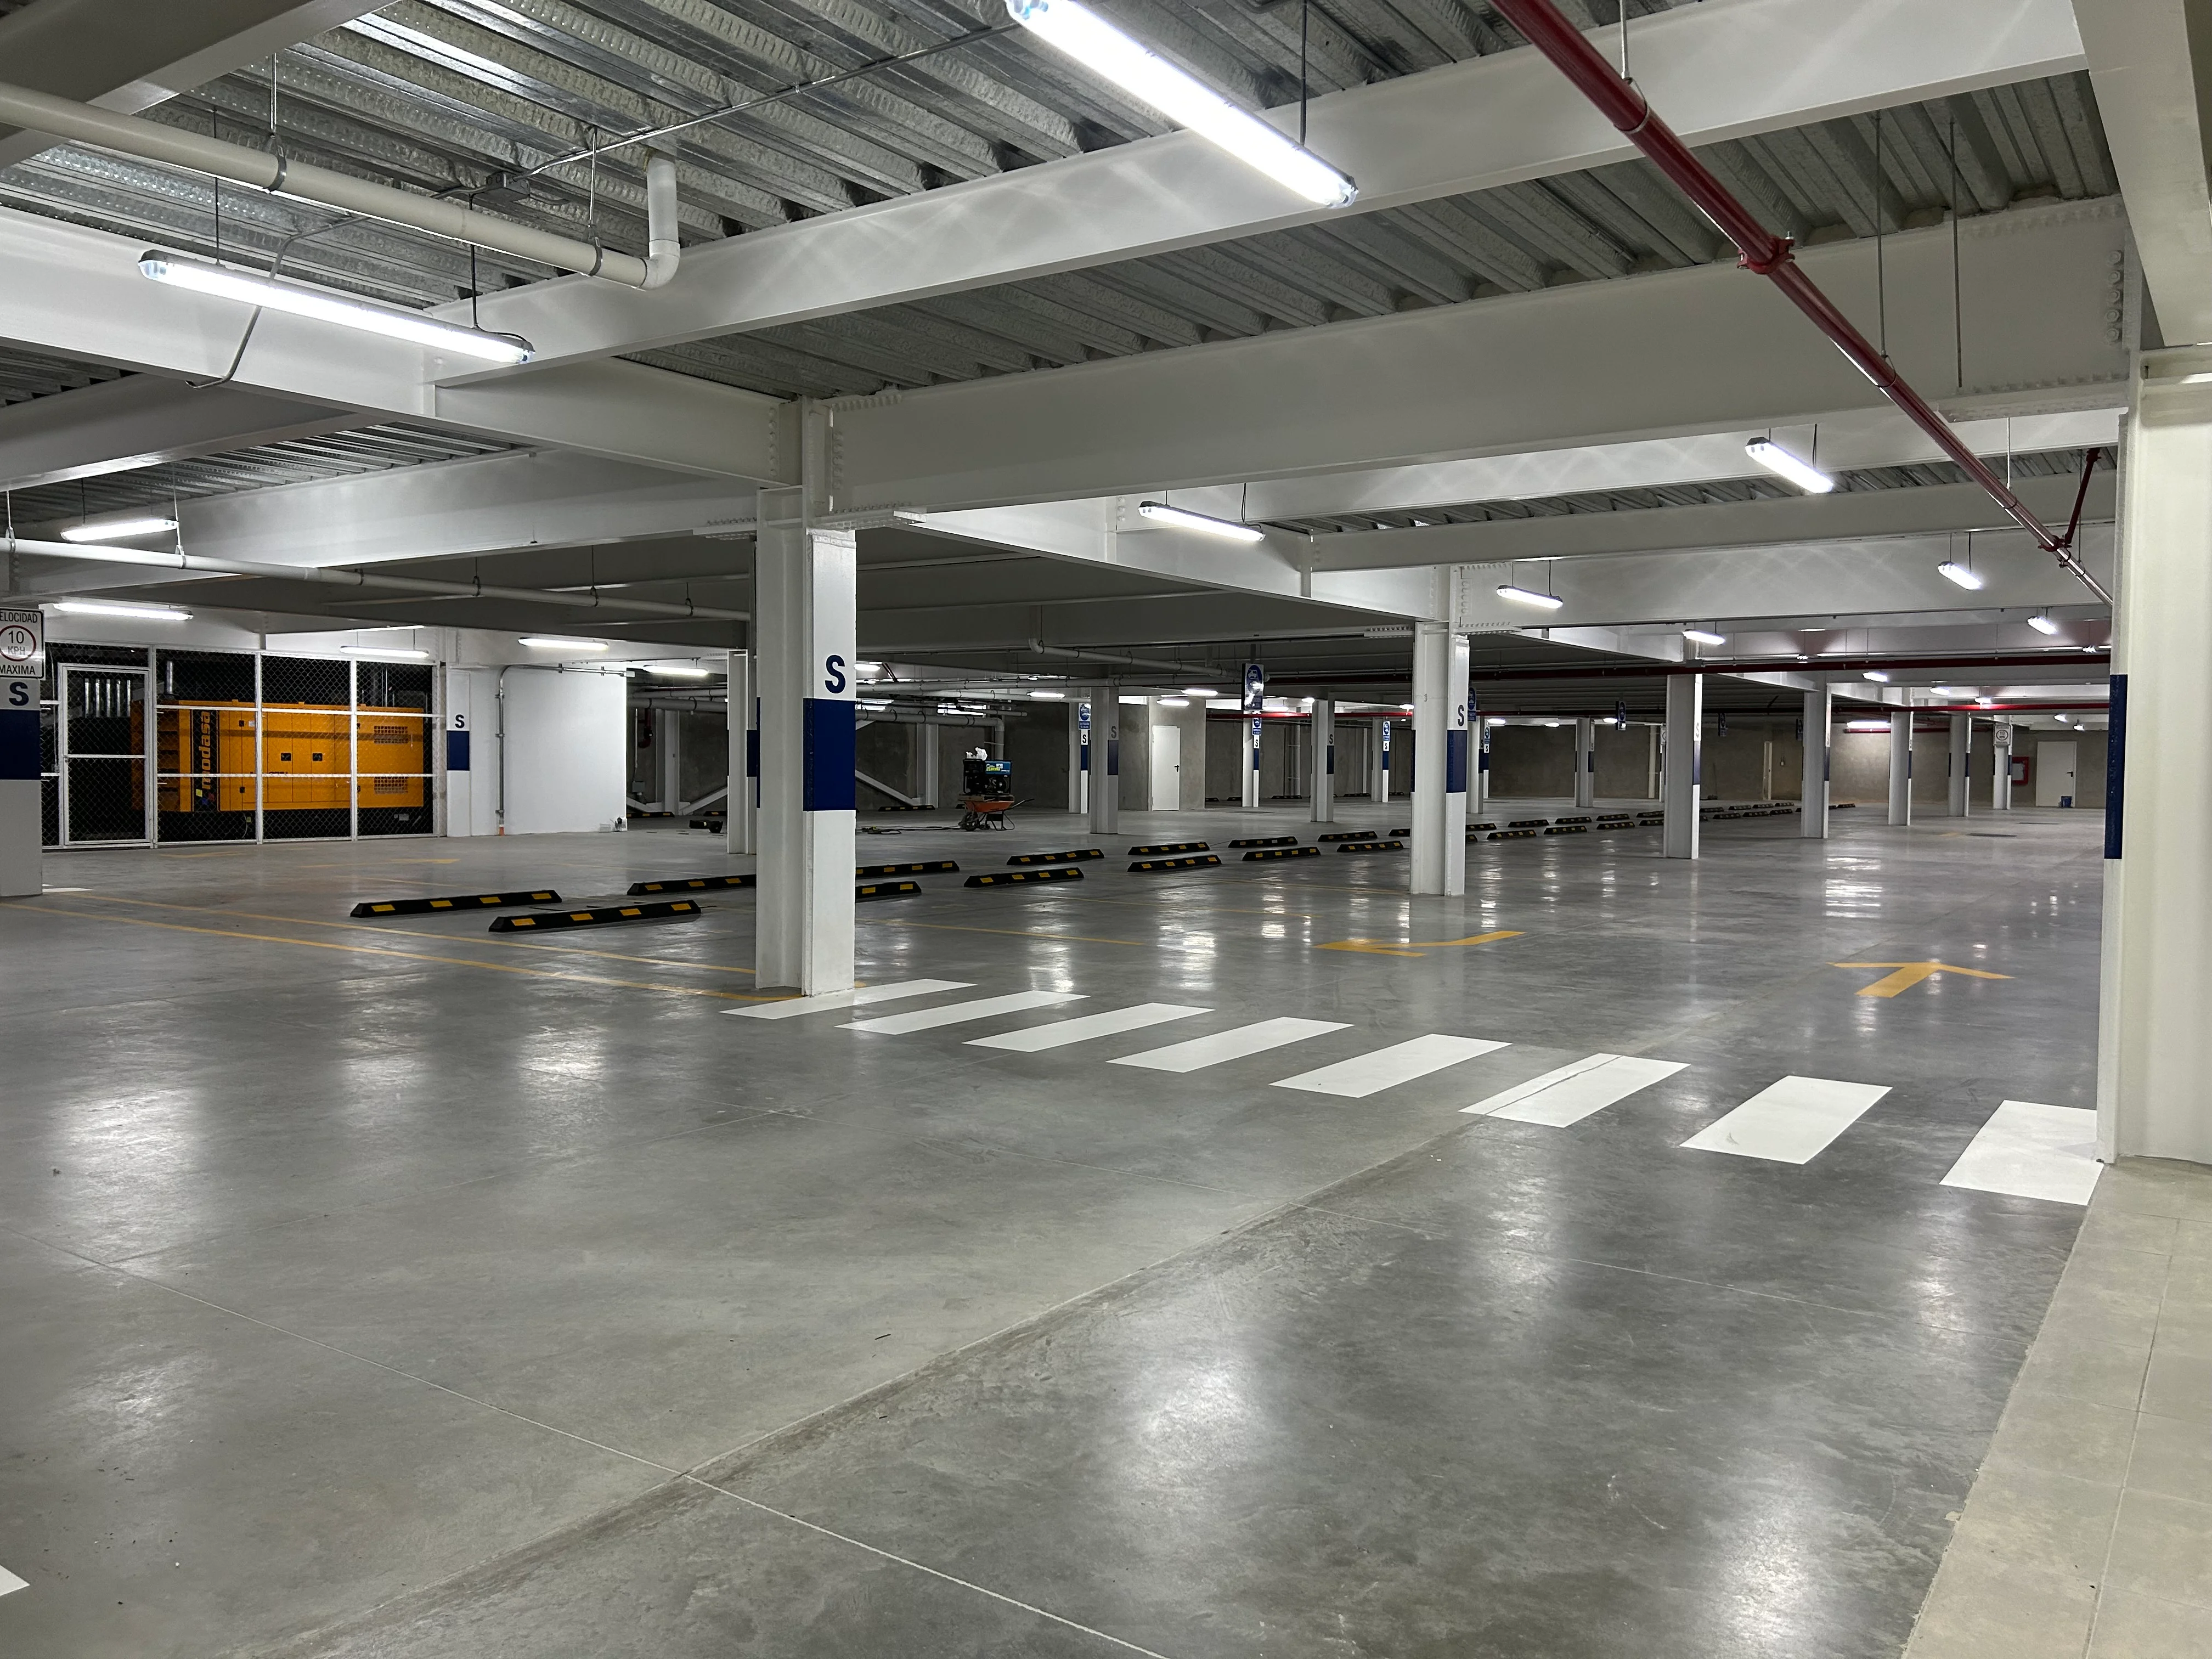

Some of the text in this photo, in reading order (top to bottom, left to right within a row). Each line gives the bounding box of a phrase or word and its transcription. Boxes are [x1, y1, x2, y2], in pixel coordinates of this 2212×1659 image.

[0, 612, 38, 623] ELOCIDAD
[8, 630, 24, 644] 10
[8, 646, 25, 656] KPH
[0, 664, 36, 675] MAXIMA
[825, 654, 846, 694] S
[9, 681, 29, 706] S
[455, 714, 465, 729] S
[1458, 704, 1464, 727] S
[1082, 734, 1087, 743] S
[1111, 725, 1117, 739] S
[1329, 734, 1333, 744] S
[199, 711, 211, 789] modasa
